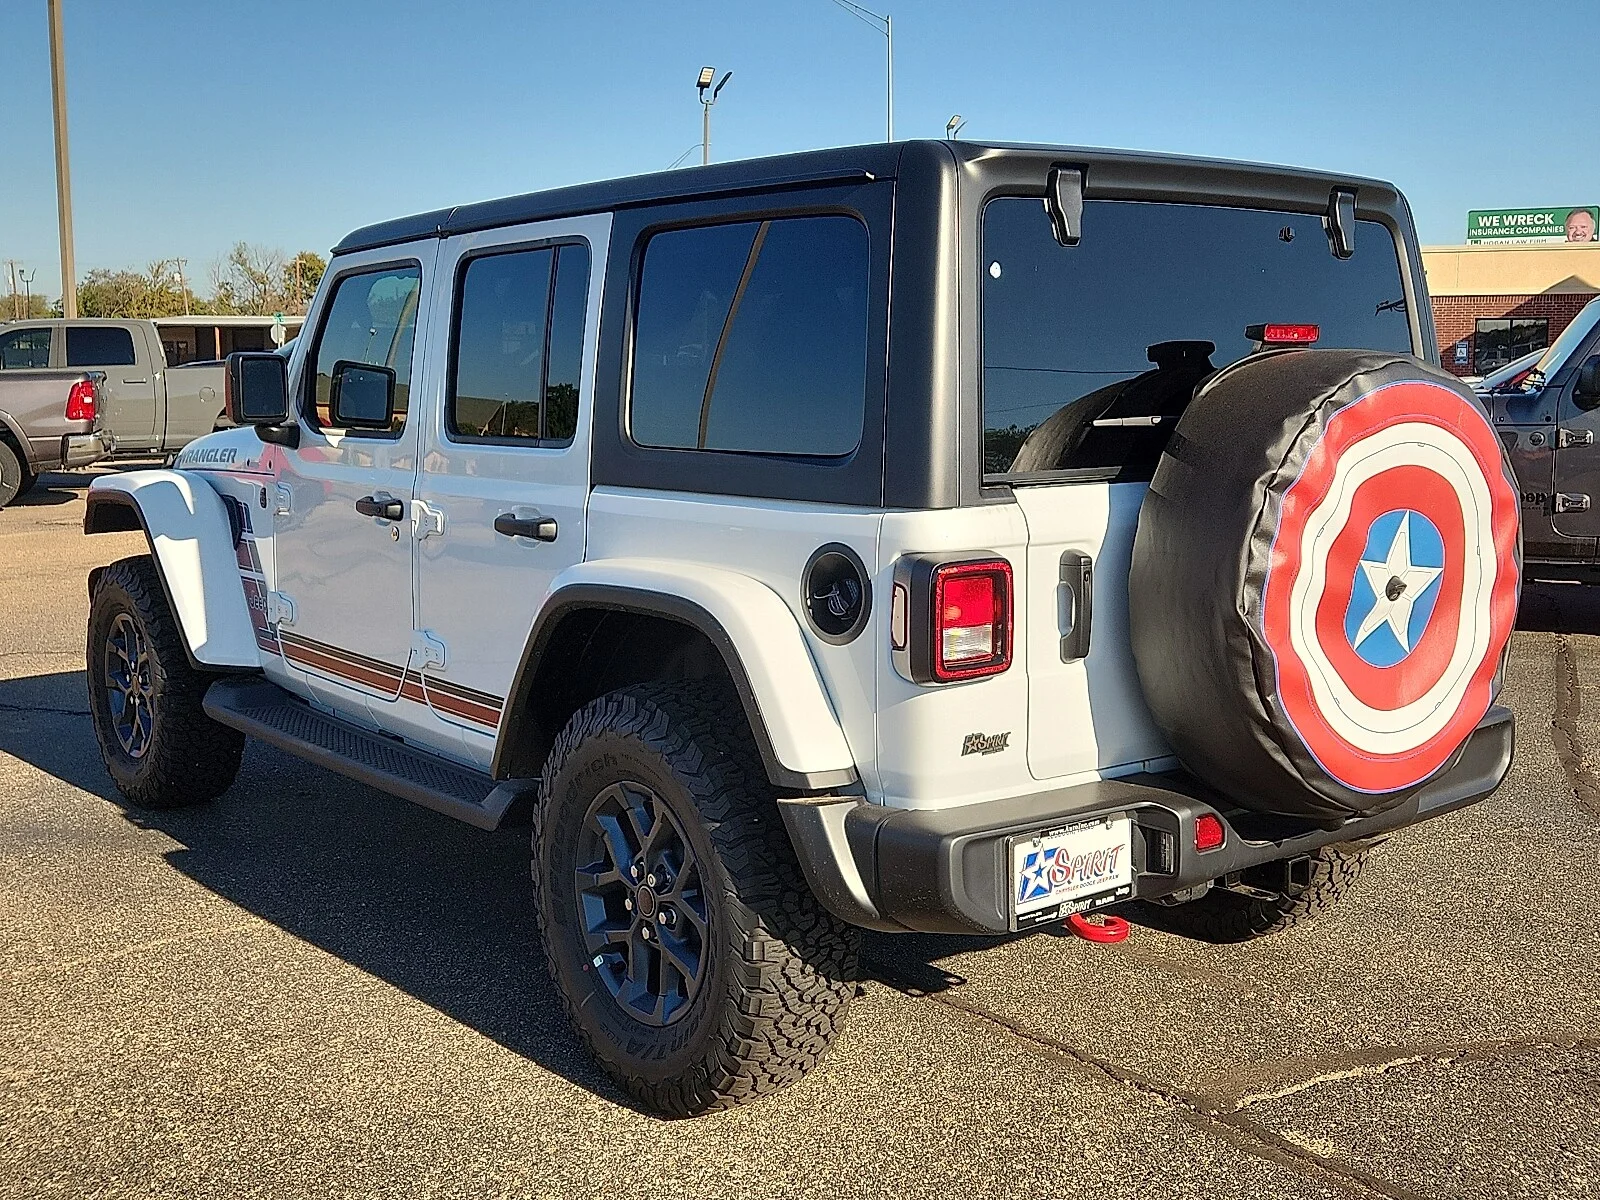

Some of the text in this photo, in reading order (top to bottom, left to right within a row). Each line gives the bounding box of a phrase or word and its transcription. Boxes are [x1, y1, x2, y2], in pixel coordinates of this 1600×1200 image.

[1478, 213, 1554, 227] WE WRECK
[1469, 225, 1564, 236] INSURANCE COMPANIES
